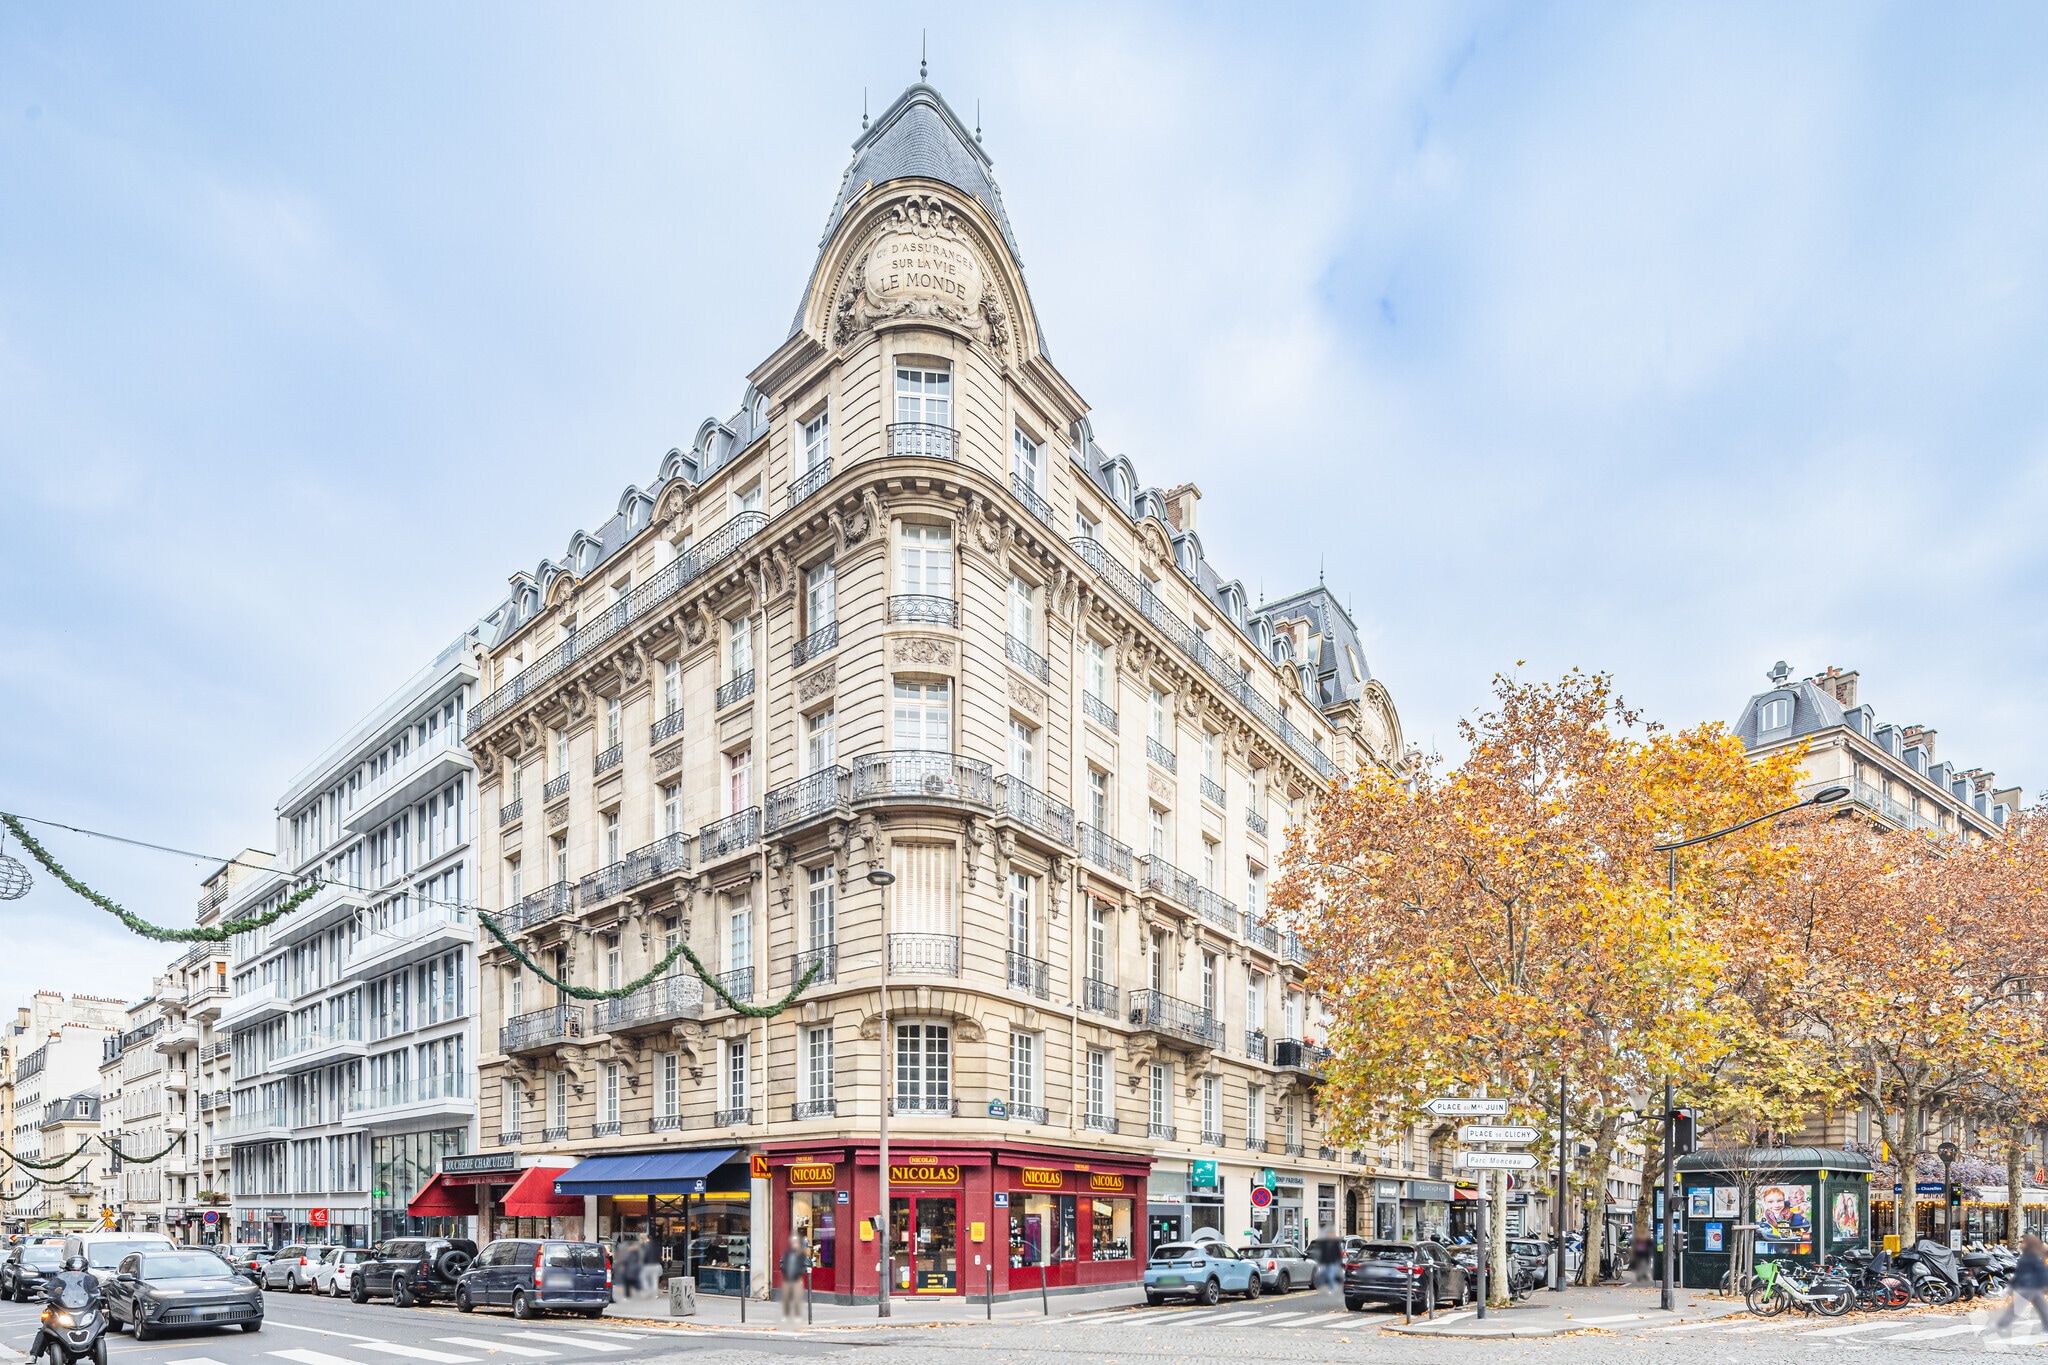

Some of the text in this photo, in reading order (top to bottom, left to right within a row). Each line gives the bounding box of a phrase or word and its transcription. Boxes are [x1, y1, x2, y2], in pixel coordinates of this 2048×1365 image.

[891, 242, 973, 271] D'ASSURANCES
[892, 258, 956, 276] SUR LA VIE
[880, 272, 966, 300] LE MONDE
[445, 1155, 513, 1171] BOUCHERIE CHARCUTERIE
[756, 1157, 768, 1172] N
[1470, 1156, 1522, 1165] Parc Monceau
[793, 1168, 832, 1181] NICOLAS
[892, 1167, 955, 1180] NICOLAS
[1025, 1170, 1060, 1184] NICOLAS
[1285, 1176, 1304, 1185] PARIBAS
[1092, 1175, 1122, 1187] NICOLAS
